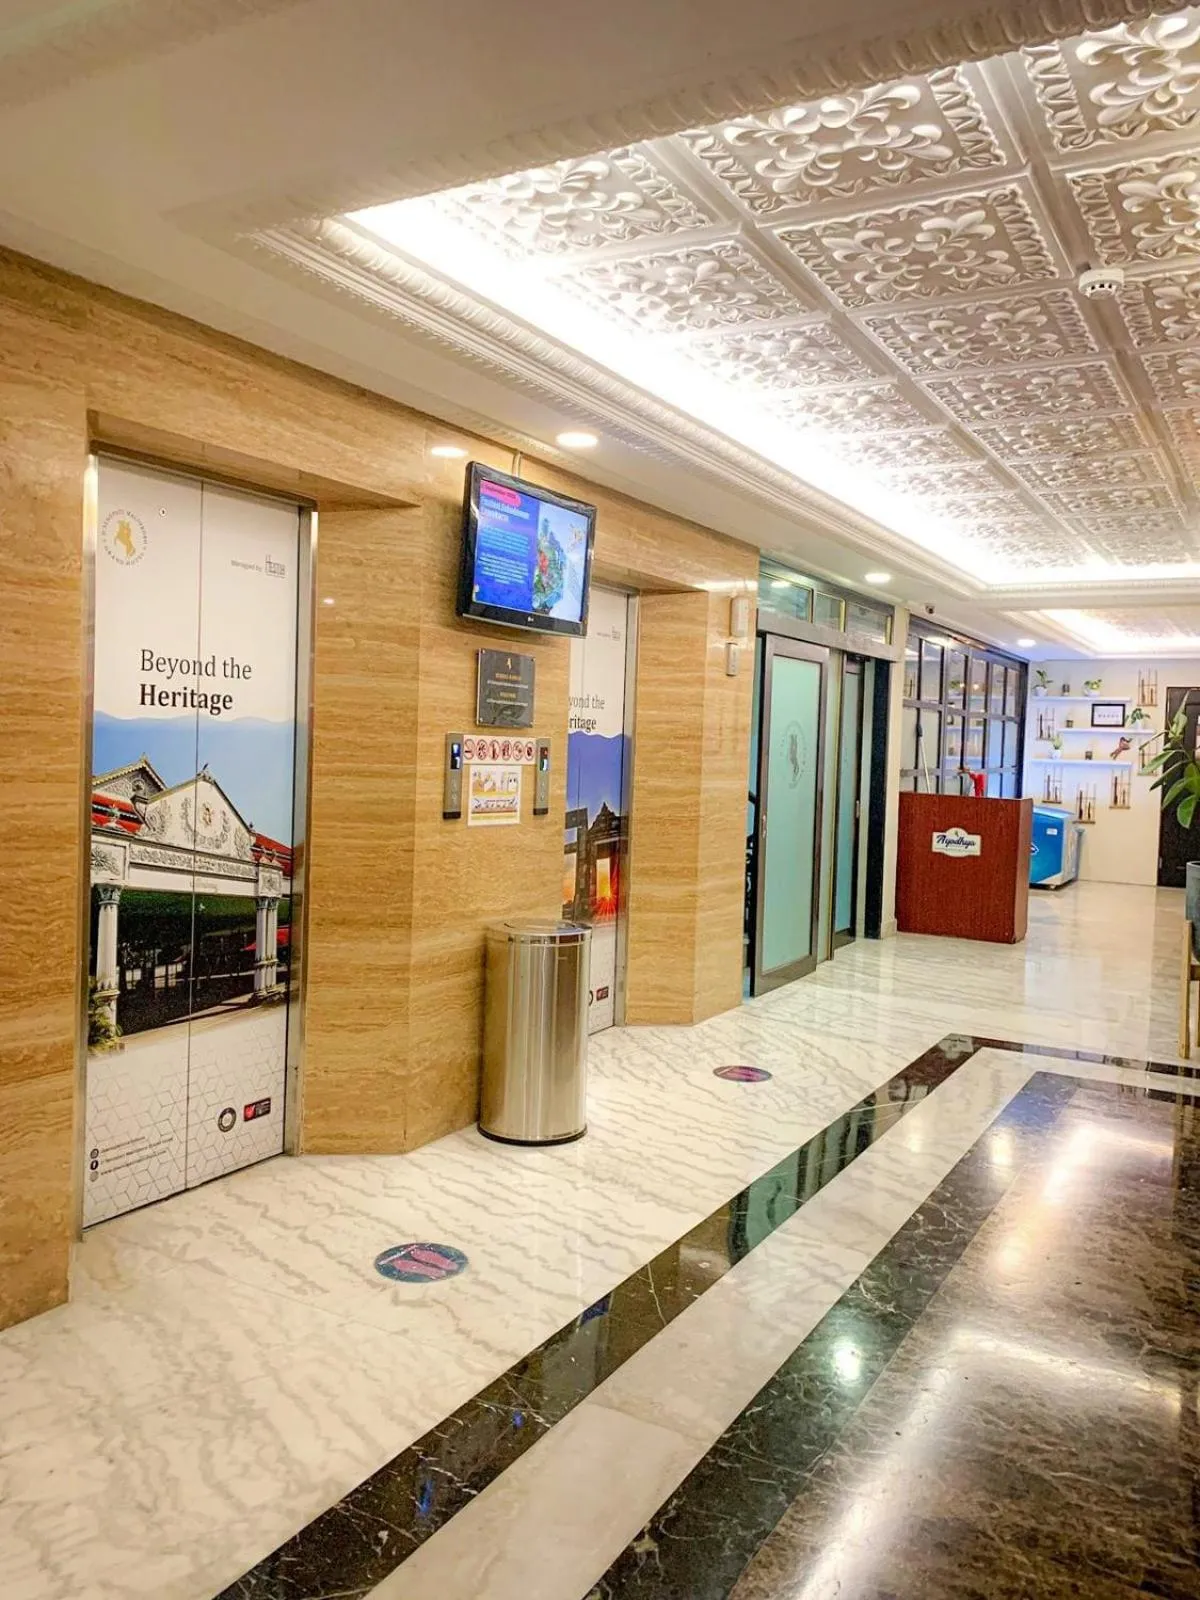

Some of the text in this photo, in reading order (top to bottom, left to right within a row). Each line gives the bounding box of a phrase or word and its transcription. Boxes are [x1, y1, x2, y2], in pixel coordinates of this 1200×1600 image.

[140, 648, 252, 680] Beyond the
[139, 683, 233, 716] Heritage
[568, 694, 605, 711] yond the
[569, 714, 597, 733] ritage
